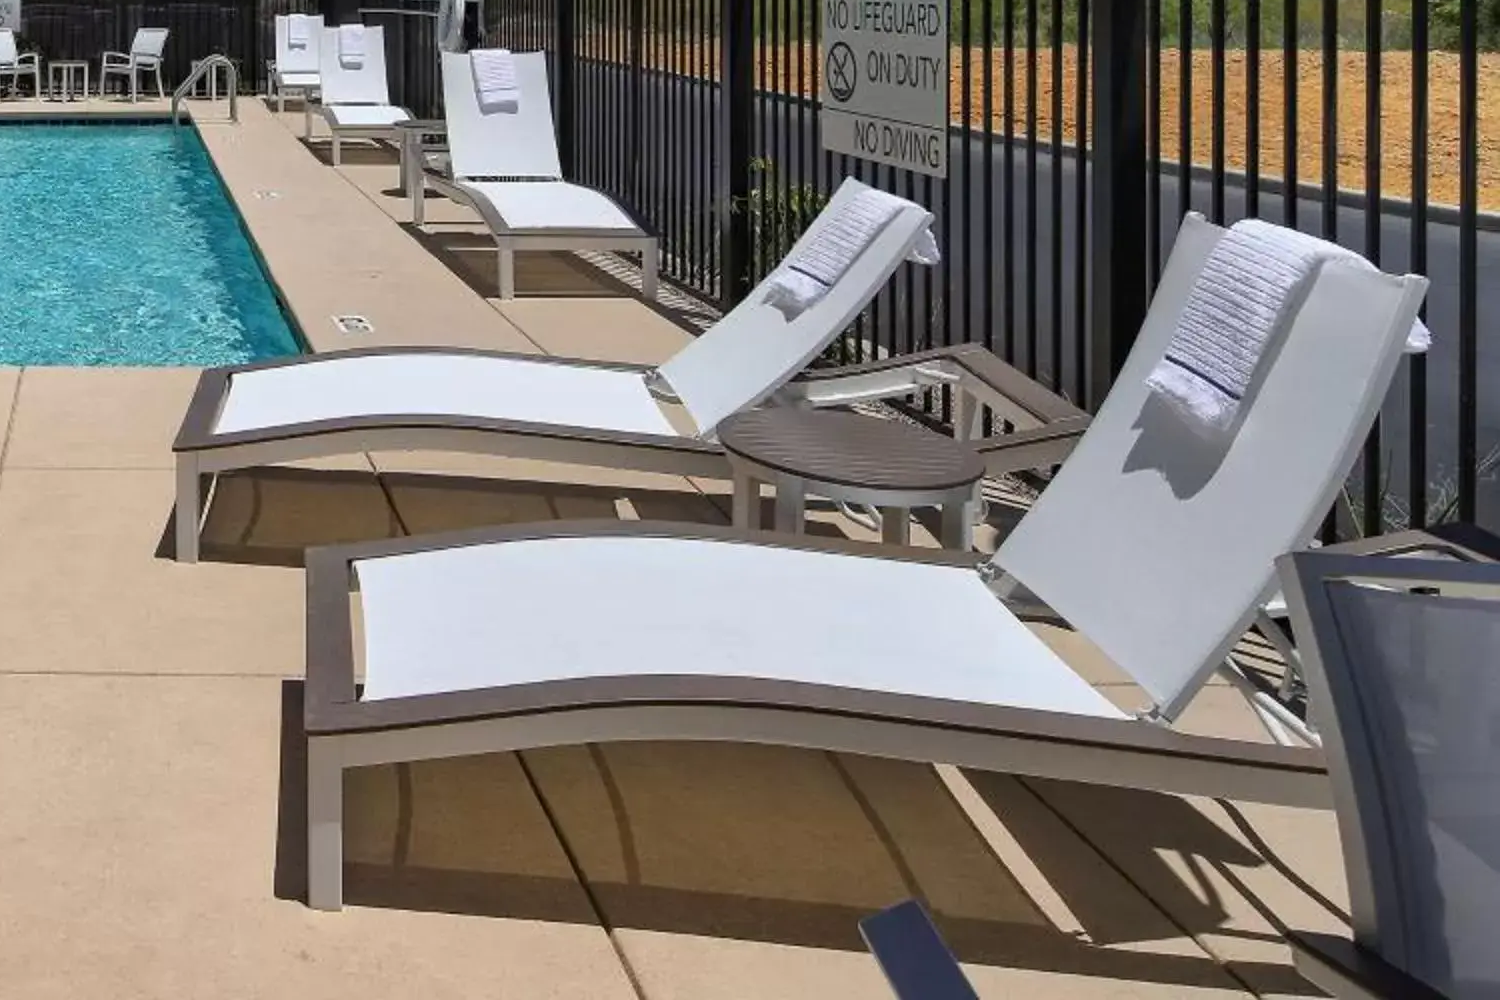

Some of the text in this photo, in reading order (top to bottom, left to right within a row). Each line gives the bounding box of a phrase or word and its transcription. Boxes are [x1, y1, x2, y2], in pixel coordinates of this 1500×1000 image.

[827, 0, 941, 36] NO LIFEGUARD
[867, 50, 941, 90] ON DUTY
[854, 119, 940, 169] NO DIVING
